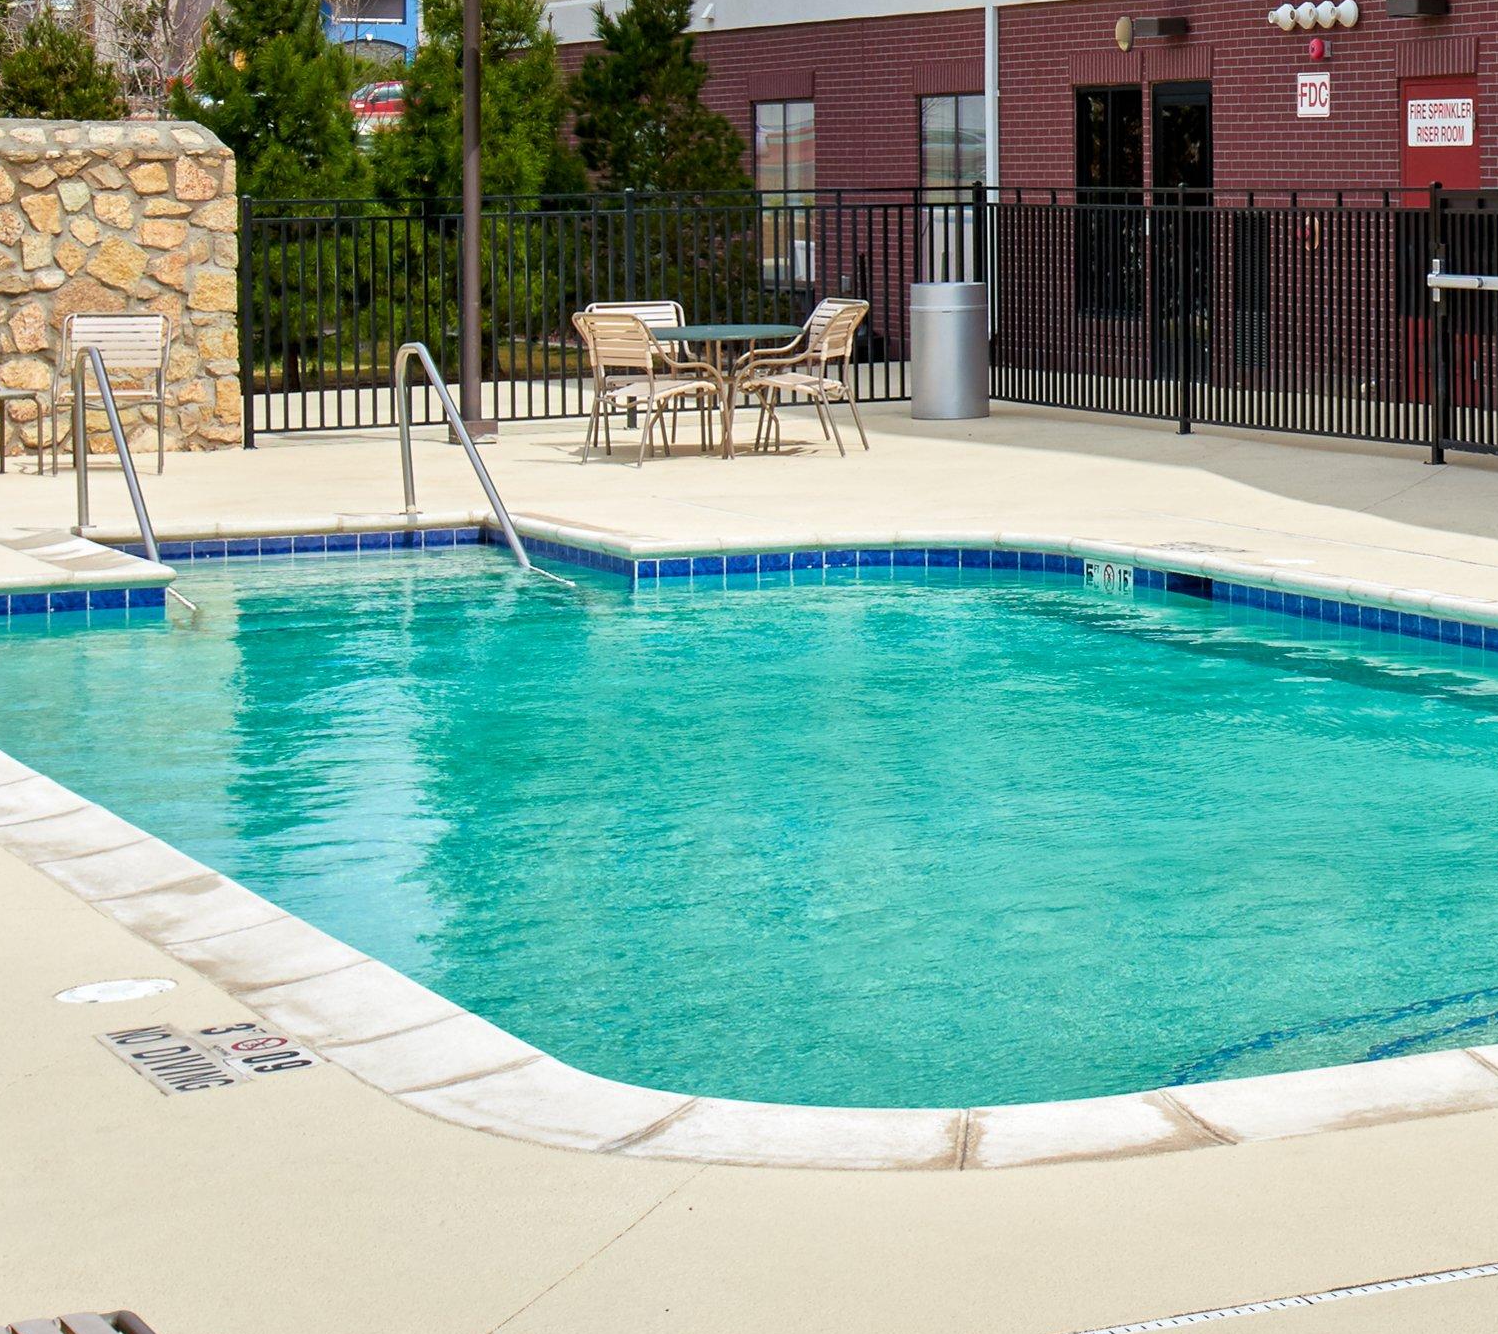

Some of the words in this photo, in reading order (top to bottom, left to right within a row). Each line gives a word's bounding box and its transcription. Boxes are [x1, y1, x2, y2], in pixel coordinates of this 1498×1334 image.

[1300, 81, 1328, 108] FDC
[1410, 104, 1427, 120] FIRE
[1428, 102, 1472, 120] SPRINKLER
[1416, 126, 1440, 143] RISER
[1441, 125, 1465, 142] ROOM
[105, 1025, 172, 1044] NO
[131, 1045, 235, 1091] DIVING
